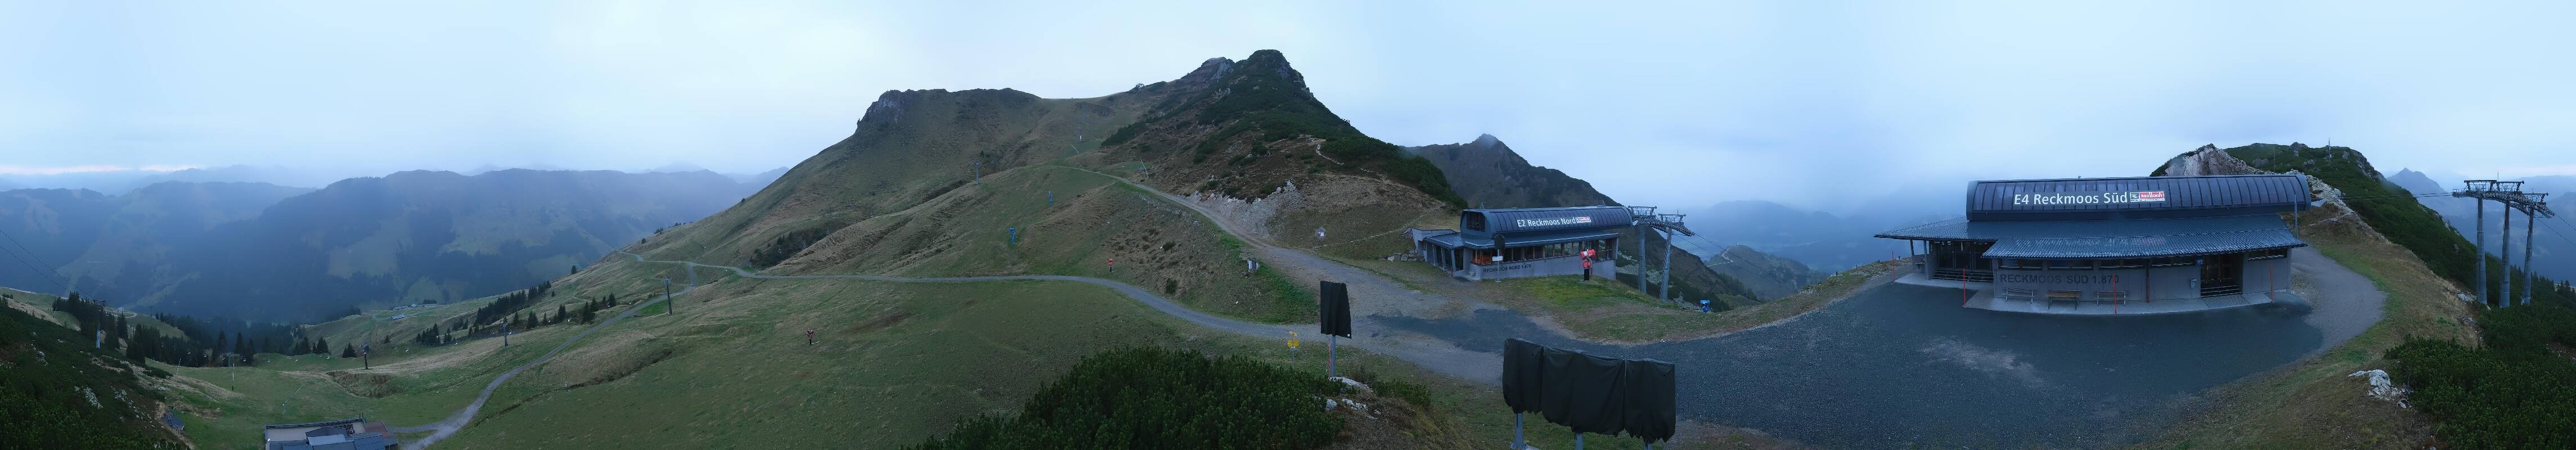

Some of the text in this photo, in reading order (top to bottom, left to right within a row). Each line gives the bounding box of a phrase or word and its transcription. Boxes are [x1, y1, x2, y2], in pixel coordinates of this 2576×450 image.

[2014, 191, 2128, 205] E4 Reckmoos Süd
[2000, 274, 2119, 284] RECKMOOS SÜD 1.870
